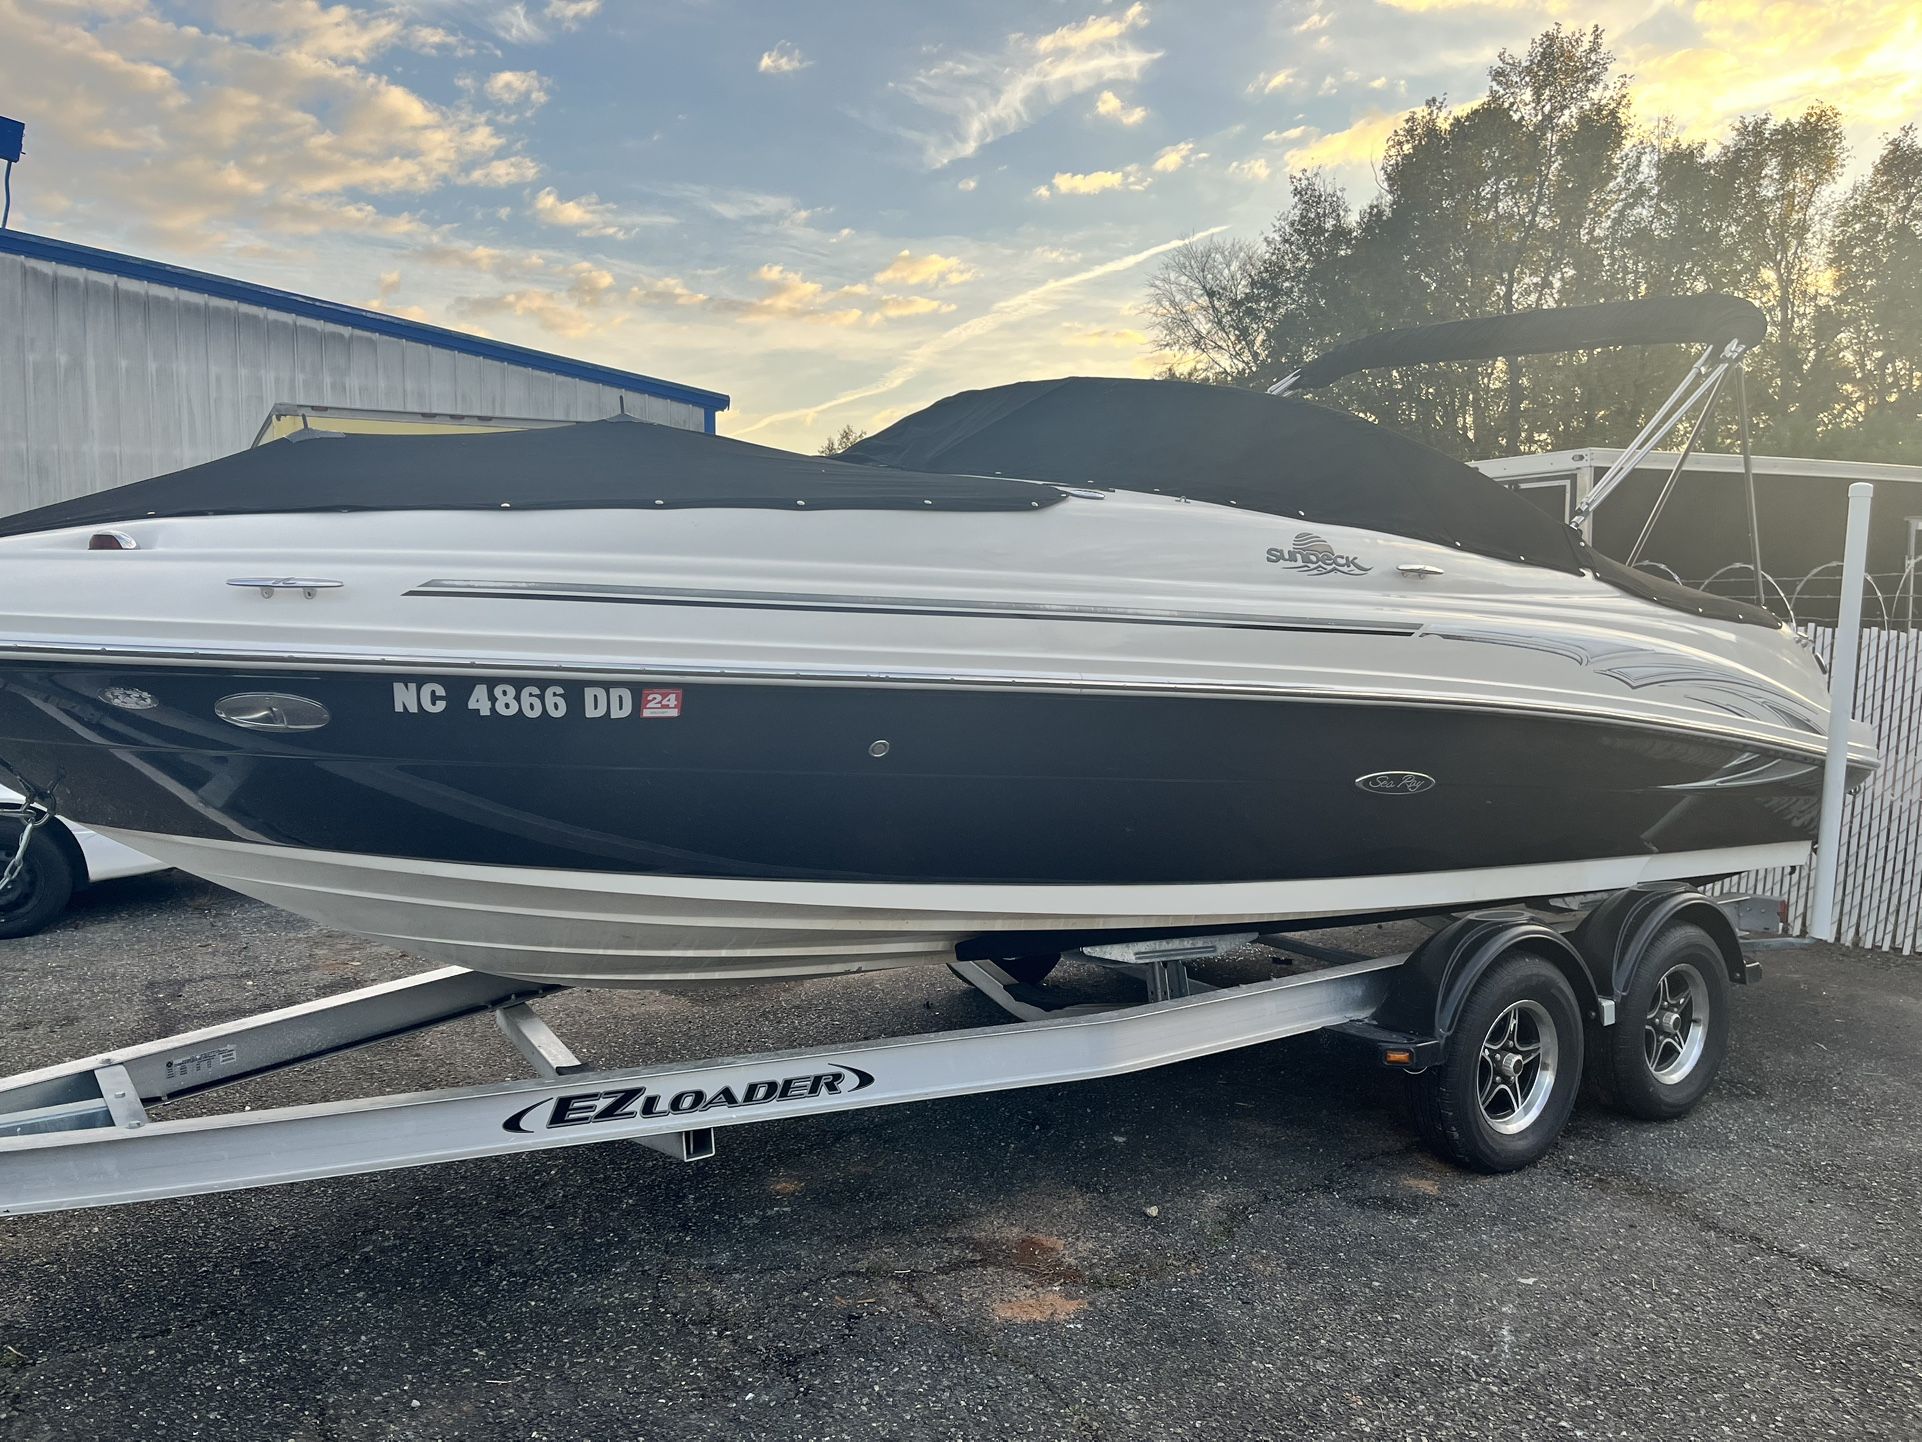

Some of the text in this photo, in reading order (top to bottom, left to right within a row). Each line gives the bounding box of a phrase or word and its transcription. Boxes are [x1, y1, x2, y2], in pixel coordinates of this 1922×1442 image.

[393, 682, 632, 719] NC 4866 DD
[646, 693, 678, 708] 24
[1369, 774, 1424, 791] Sea Ray
